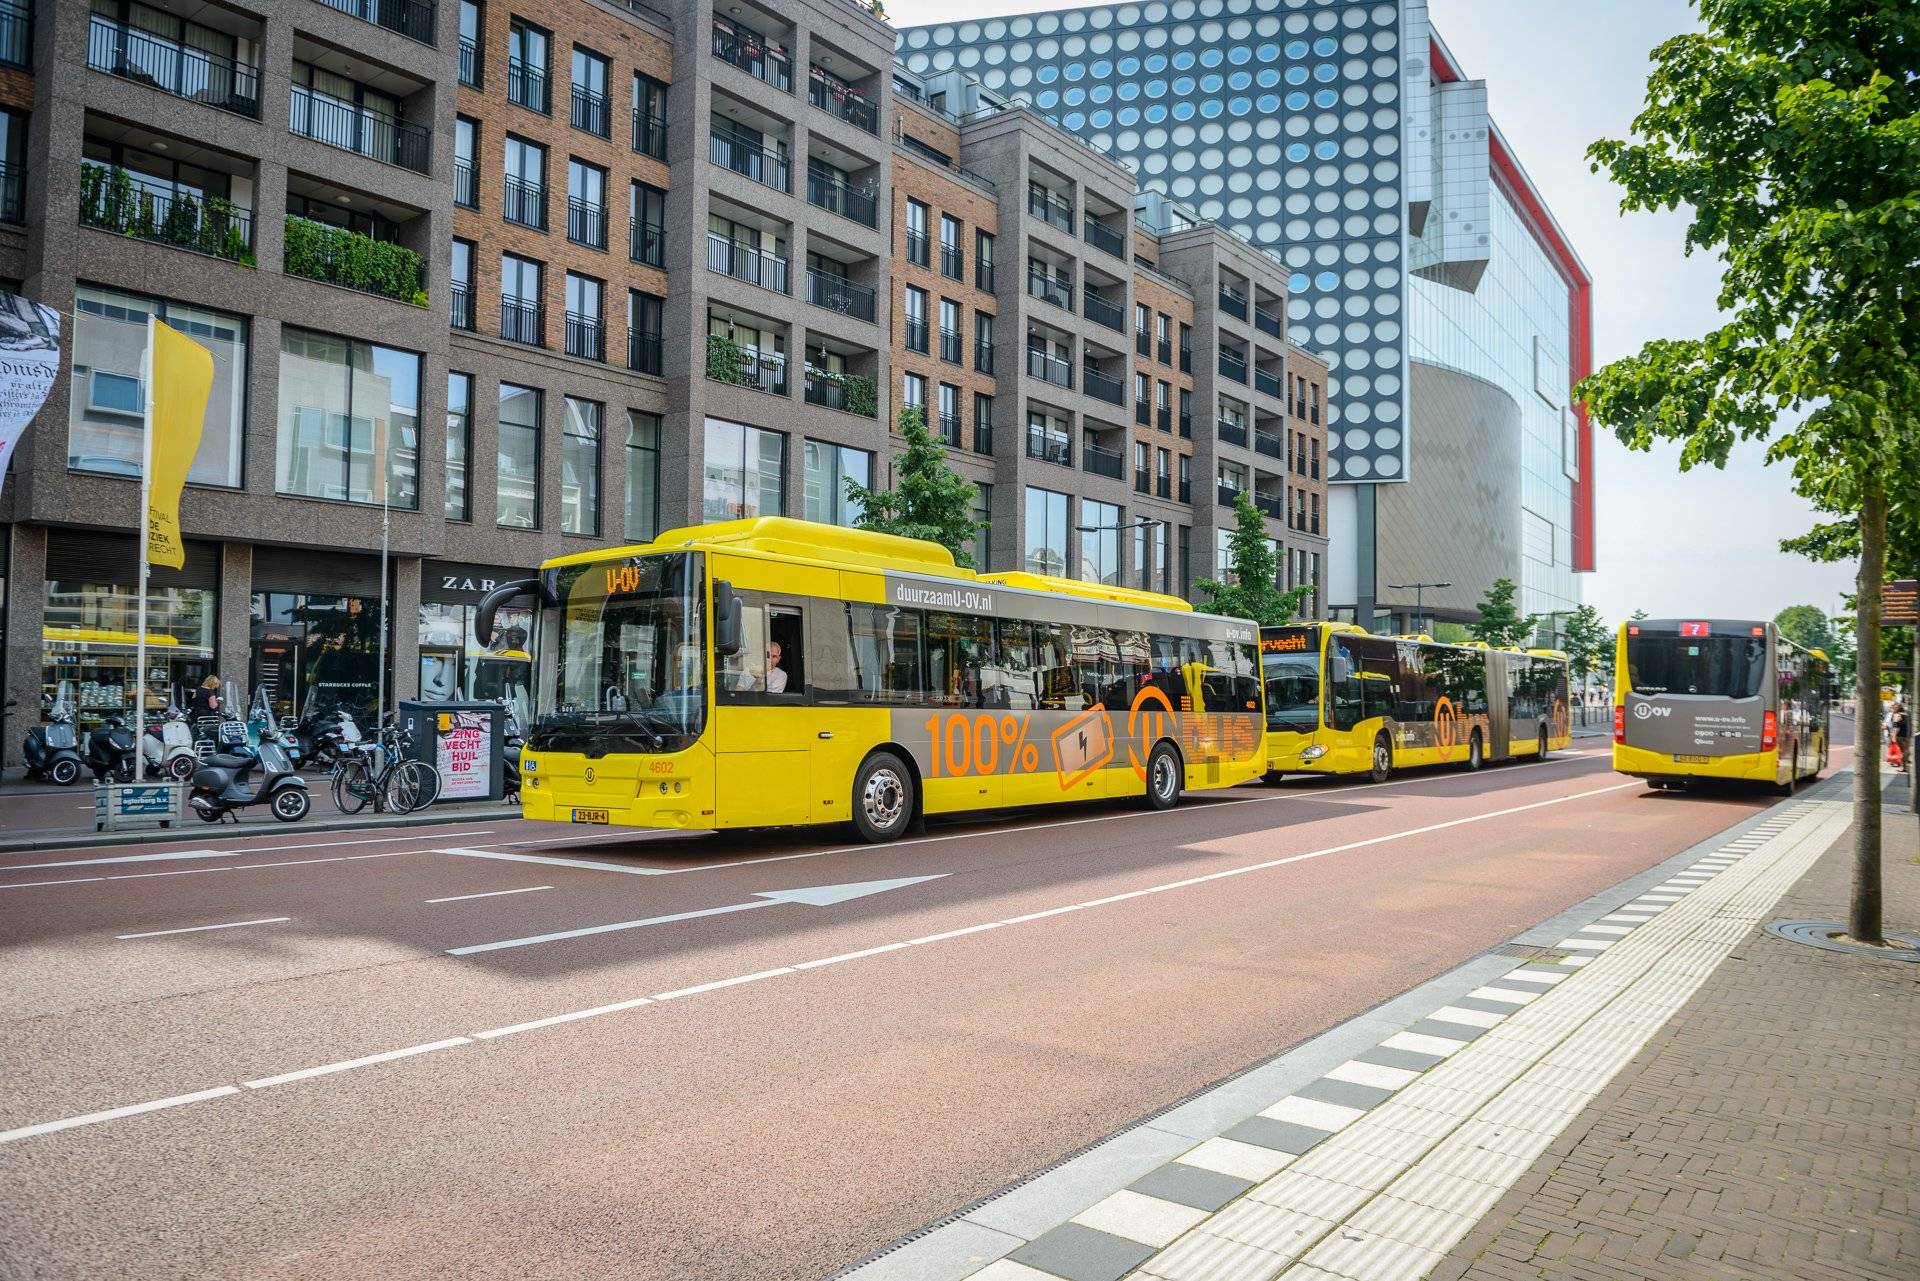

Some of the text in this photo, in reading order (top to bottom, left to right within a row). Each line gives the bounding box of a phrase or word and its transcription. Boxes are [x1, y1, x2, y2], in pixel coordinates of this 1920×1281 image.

[607, 565, 639, 593] U-OV
[896, 583, 993, 611] duurzaamU-OV.nl
[1690, 623, 1701, 636] 7
[453, 729, 480, 739] ZING
[445, 740, 481, 750] VECHT
[925, 713, 1040, 778] 100%
[452, 751, 478, 761] HUIL
[452, 762, 471, 772] BID
[649, 761, 674, 774] 4602
[577, 811, 606, 822] 23-BJR-4
